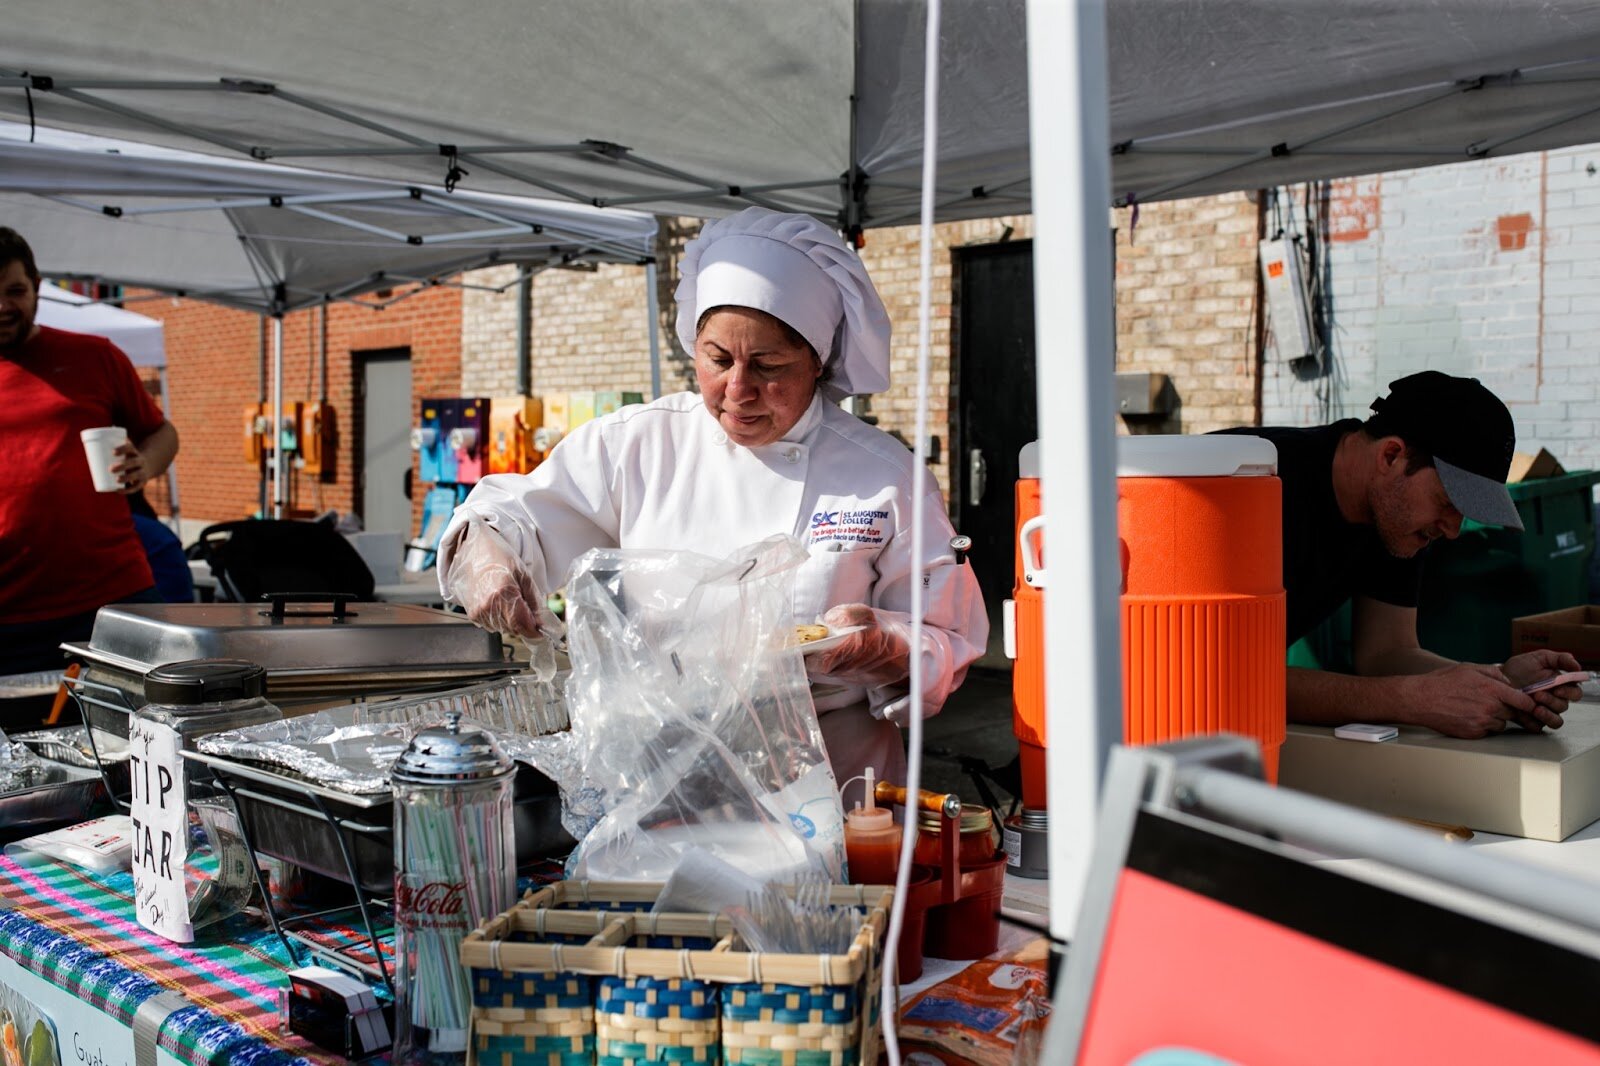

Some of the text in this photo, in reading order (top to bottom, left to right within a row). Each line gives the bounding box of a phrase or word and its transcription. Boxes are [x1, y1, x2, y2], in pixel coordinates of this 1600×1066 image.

[811, 511, 839, 528] SAC
[821, 528, 836, 536] bridge
[131, 755, 172, 809] TIP
[133, 817, 172, 880] JAR
